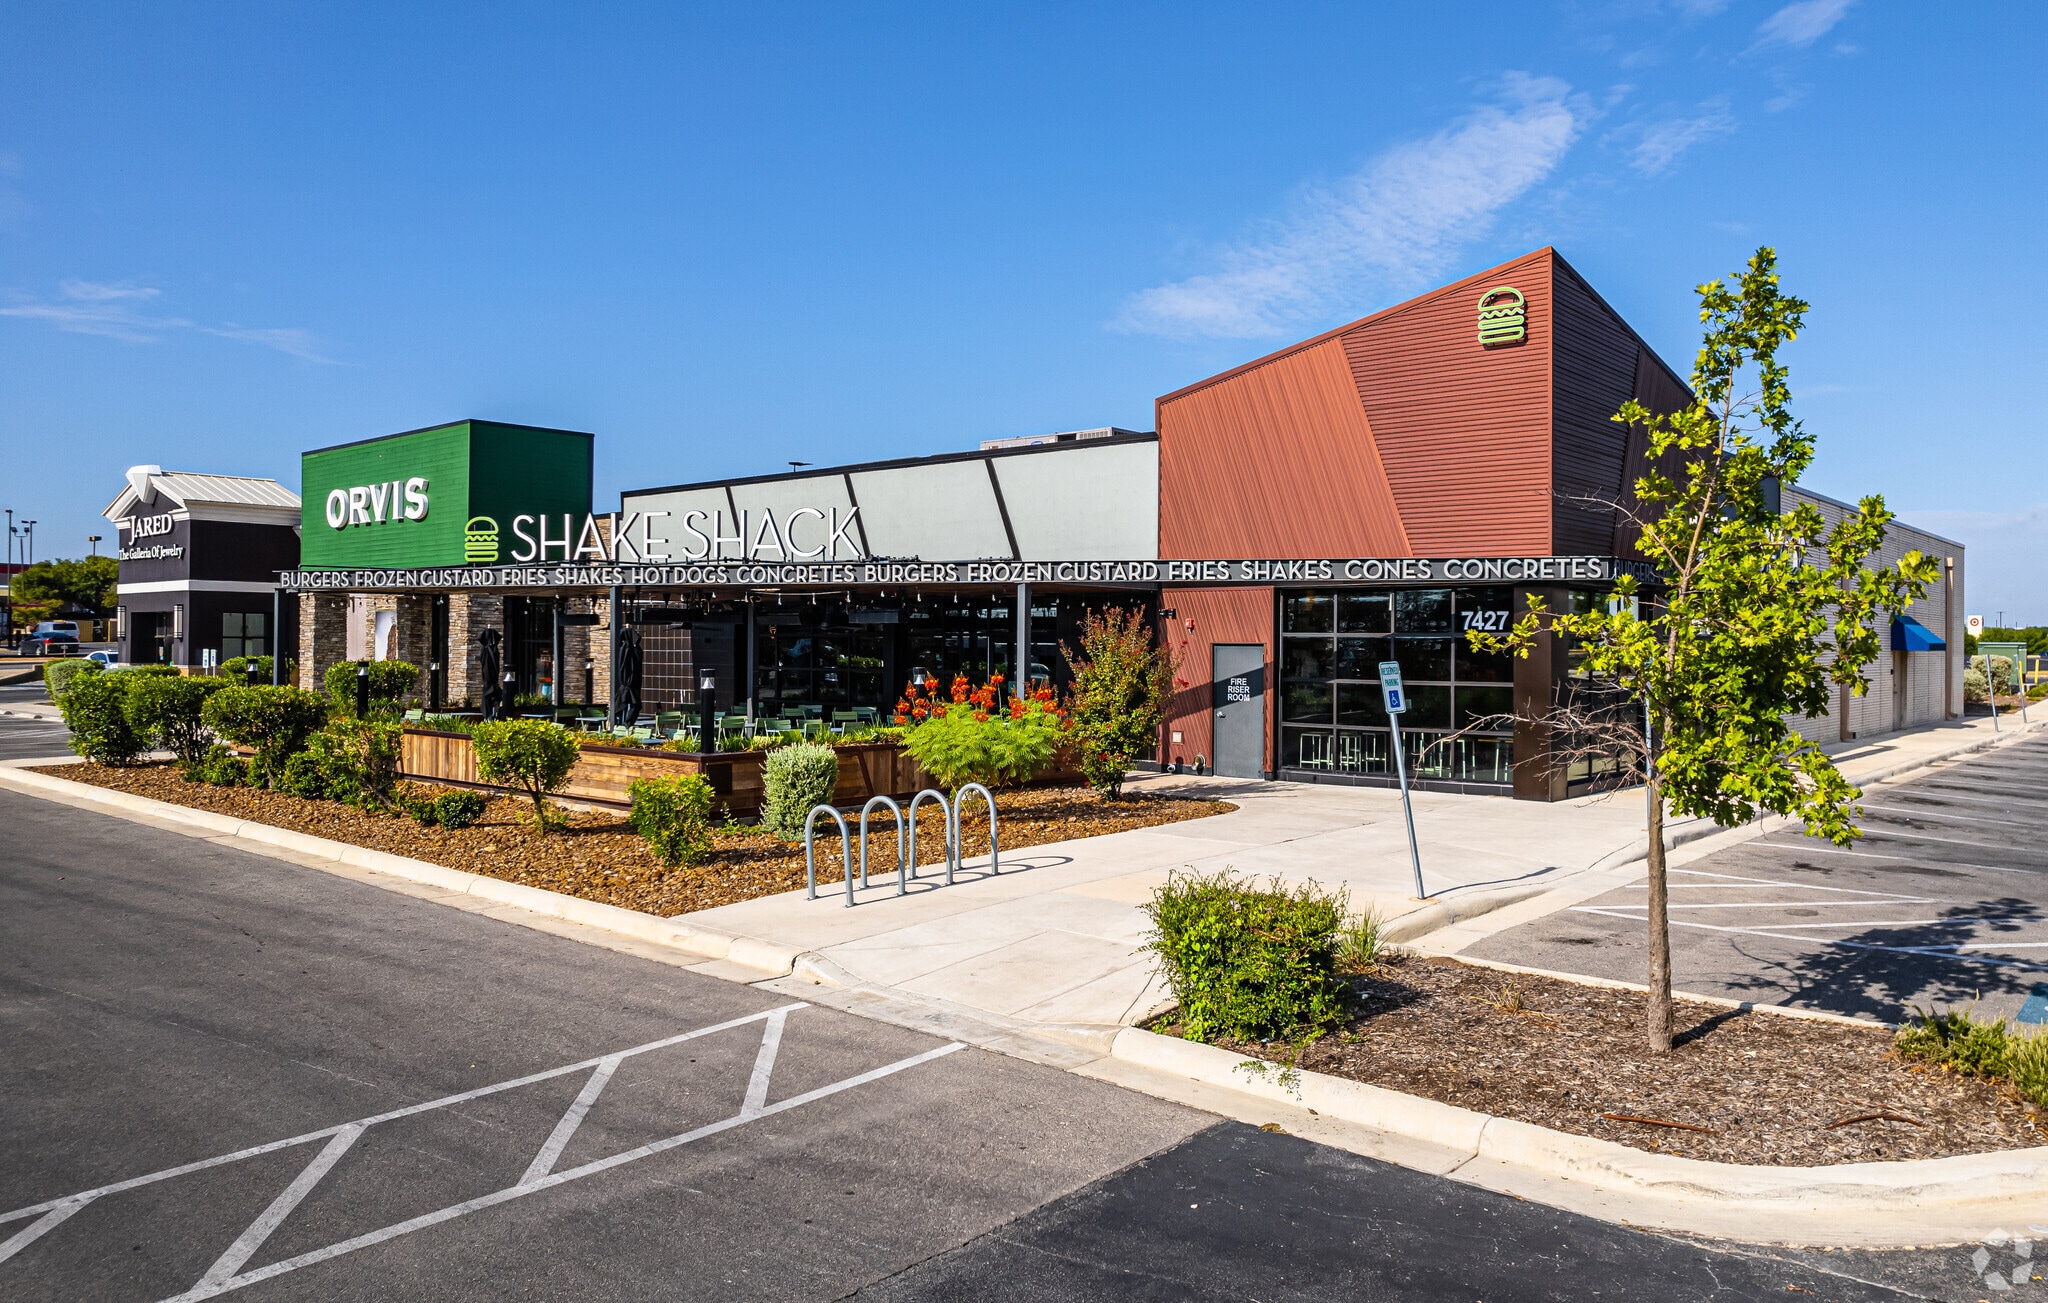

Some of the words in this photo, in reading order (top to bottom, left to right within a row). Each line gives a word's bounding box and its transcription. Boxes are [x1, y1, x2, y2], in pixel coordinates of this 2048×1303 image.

[326, 477, 429, 528] ORVIS
[128, 514, 172, 545] JARED
[511, 511, 672, 561] SHAKE
[681, 506, 862, 559] SHACK
[119, 547, 130, 561] The
[129, 547, 151, 560] Galleria
[151, 544, 160, 558] Of
[159, 544, 184, 560] Jewelry
[280, 571, 349, 588] BURGERS
[355, 570, 417, 587] FROZEN
[420, 569, 493, 587] CUSTARD
[501, 568, 547, 586] FRIES
[554, 567, 623, 585] SHAKES
[632, 567, 669, 584] HOT
[674, 566, 727, 584] DOGS
[736, 564, 855, 583] CONCRETES
[865, 564, 958, 582] BURGERS
[968, 562, 1052, 582] FROZEN
[1057, 562, 1158, 581] CUSTARD
[1168, 560, 1230, 580] FRIES
[1240, 560, 1333, 580] SHAKES
[1344, 559, 1432, 580] CONES
[1443, 558, 1602, 580] CONCRETES
[1461, 610, 1510, 631] 7427
[1227, 685, 1250, 693] RISER
[1227, 693, 1250, 702] ROOM
